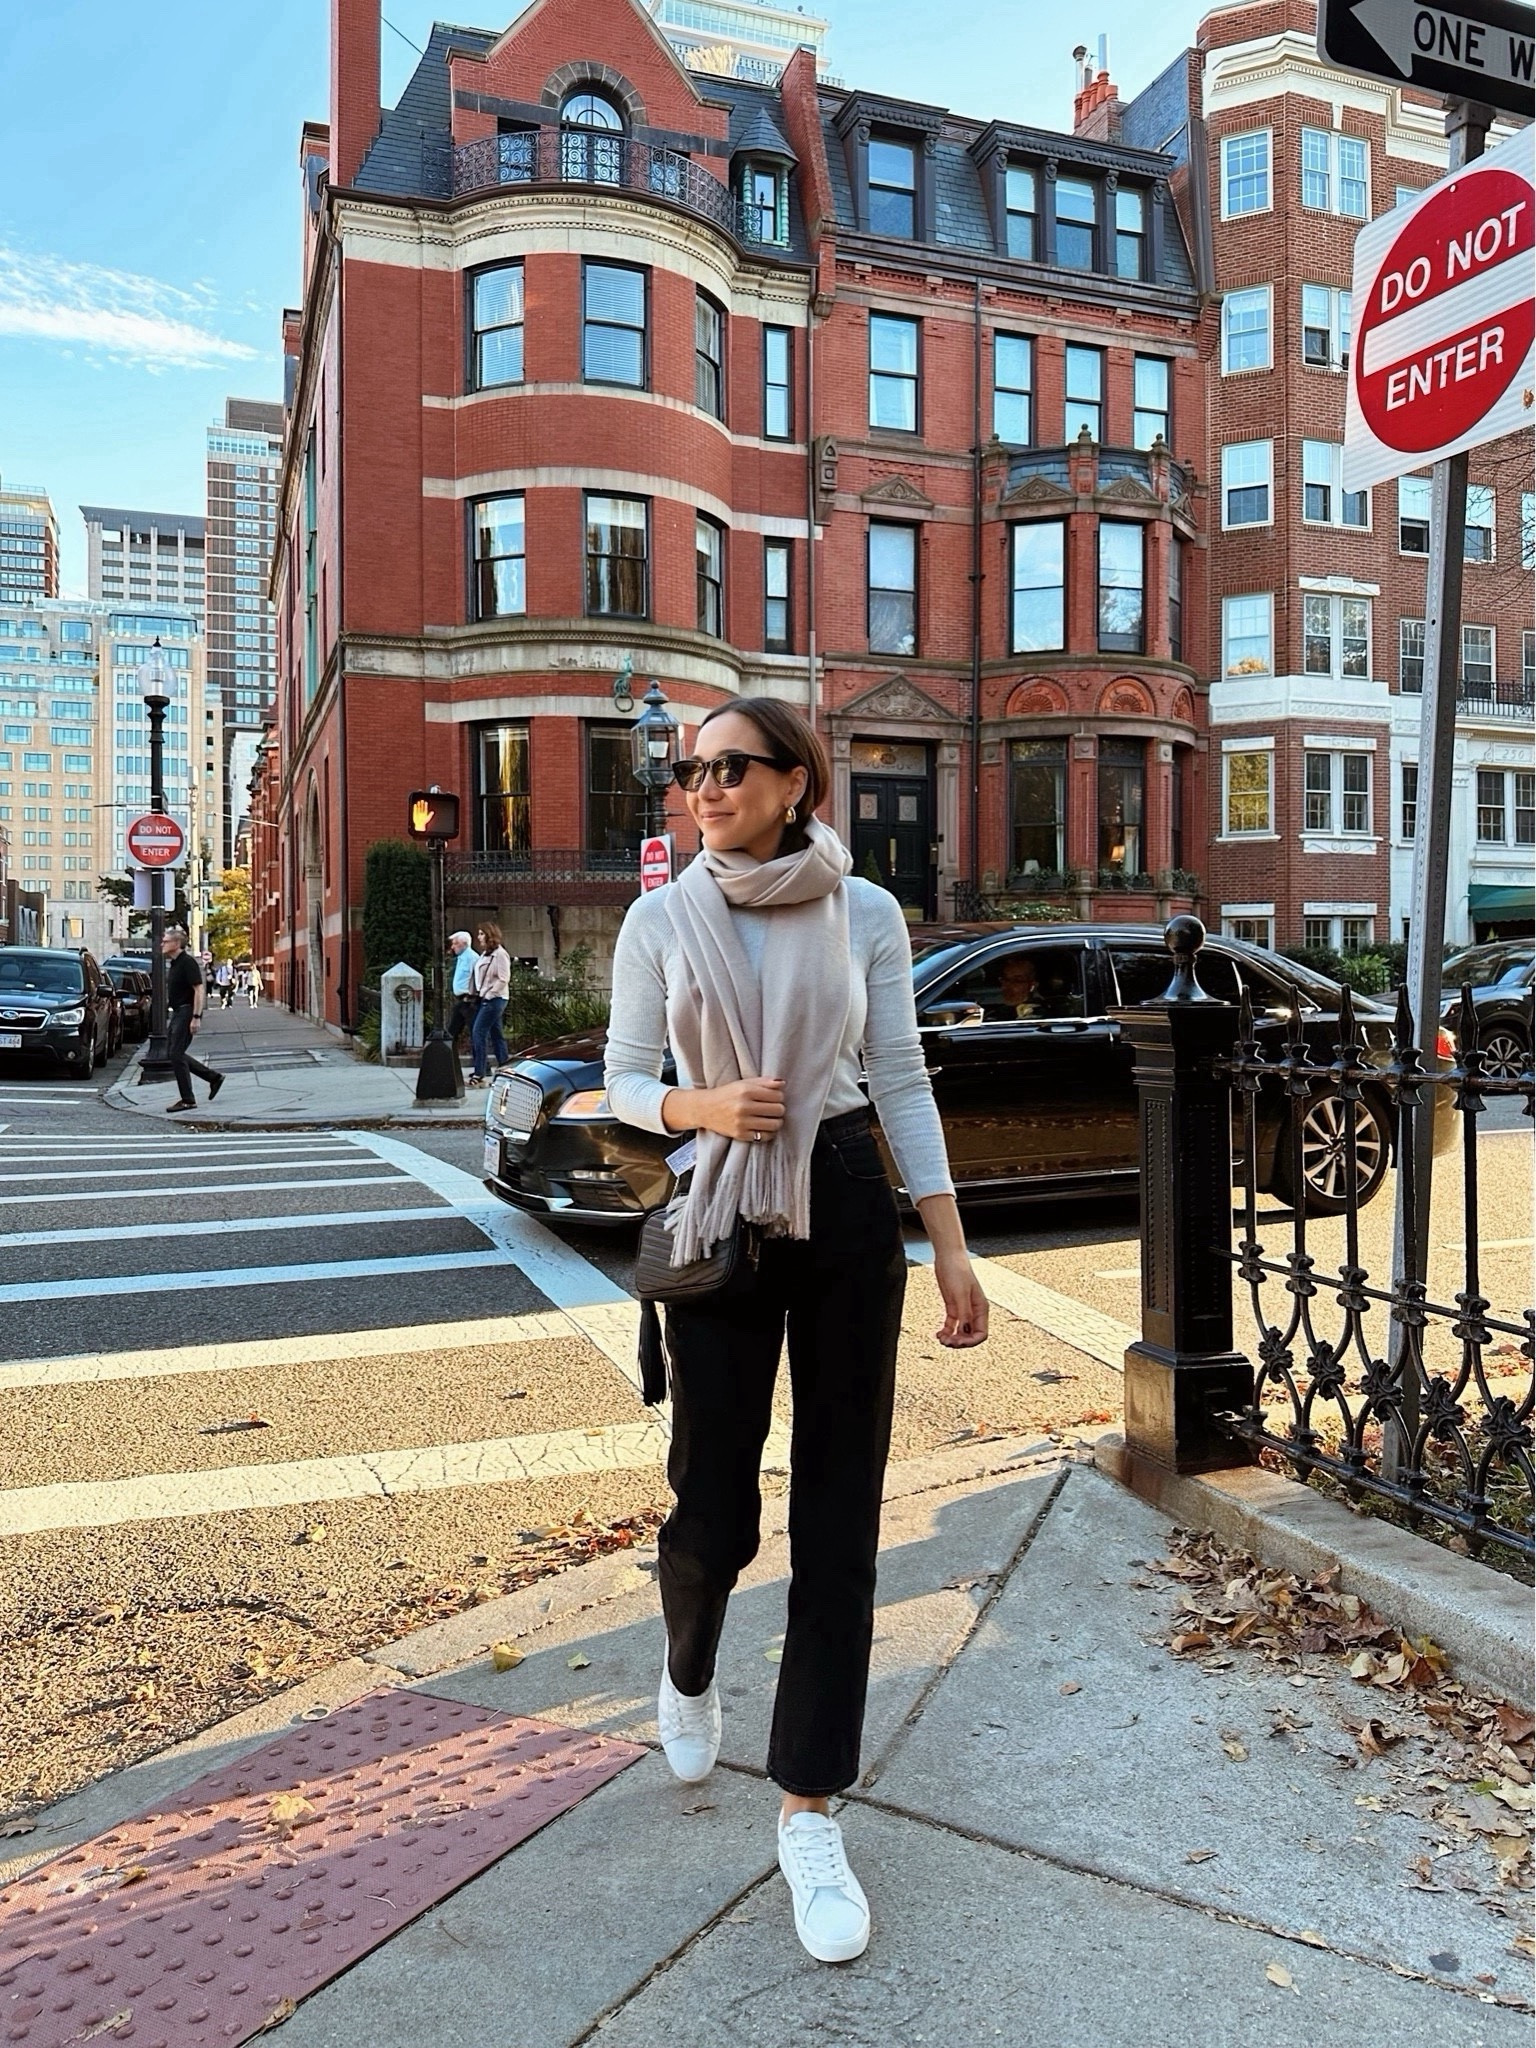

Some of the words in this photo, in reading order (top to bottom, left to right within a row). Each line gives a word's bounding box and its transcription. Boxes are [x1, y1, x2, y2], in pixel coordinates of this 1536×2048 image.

[1414, 10, 1486, 68] ONE
[1509, 36, 1535, 83] W
[1381, 256, 1431, 314] DO
[1447, 201, 1526, 279] NOT
[1386, 326, 1505, 412] ENTER
[1502, 748, 1525, 760] 250
[140, 825, 152, 834] DO
[155, 825, 172, 834] NOT
[142, 847, 170, 856] ENTER
